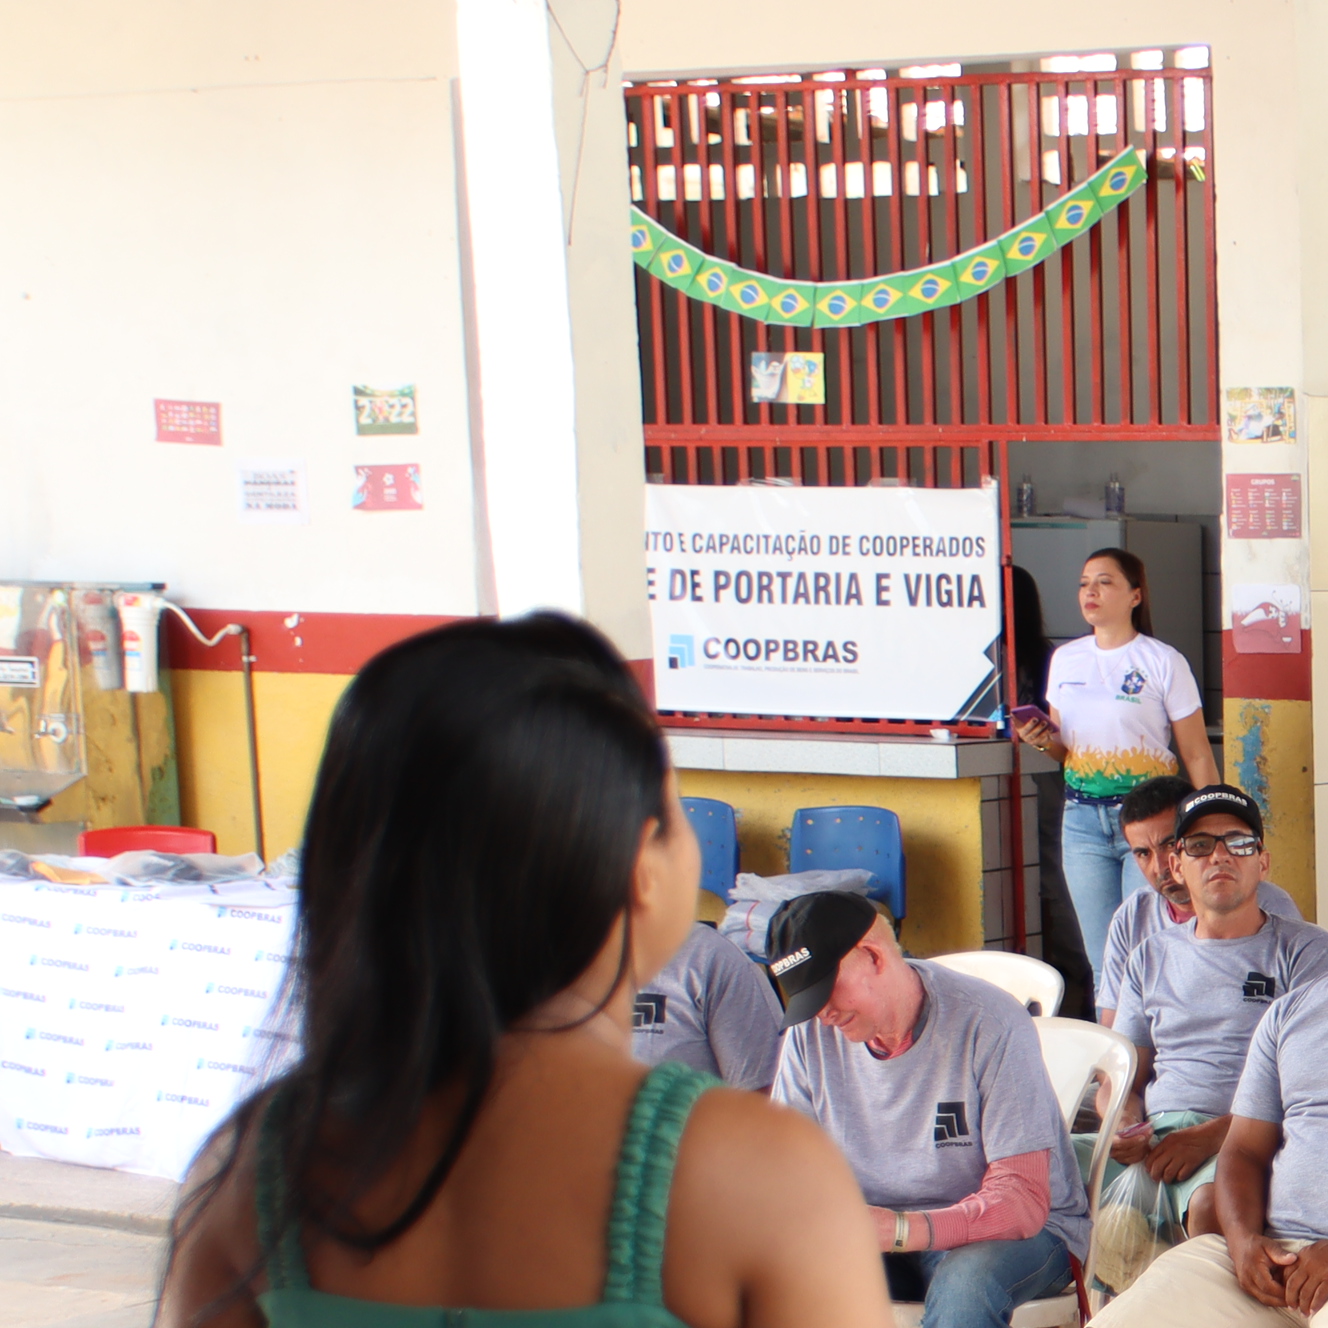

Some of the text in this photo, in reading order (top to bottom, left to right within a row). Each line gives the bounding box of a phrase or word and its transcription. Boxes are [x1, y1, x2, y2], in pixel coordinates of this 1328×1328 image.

[692, 530, 822, 561] CAPACITAÇÃO
[828, 535, 851, 556] DE
[858, 535, 986, 558] COOPERADOS
[668, 568, 705, 602] DE
[713, 569, 864, 606] PORTARIA
[875, 573, 891, 606] E
[903, 573, 987, 608] VIGIA
[702, 637, 859, 664] COOPBRAS
[1194, 793, 1248, 807] COOPBRAS
[230, 909, 283, 924] COOPBRAS
[86, 926, 138, 938] COOPBRAS
[181, 941, 232, 955] COOPBRAS
[41, 957, 90, 972] COOPBRAS
[218, 985, 268, 999] COOPBRAS
[172, 1017, 219, 1031] COOPBRAS
[39, 1032, 85, 1046] COOPBRAS
[935, 1141, 973, 1149] COOPBRAS
